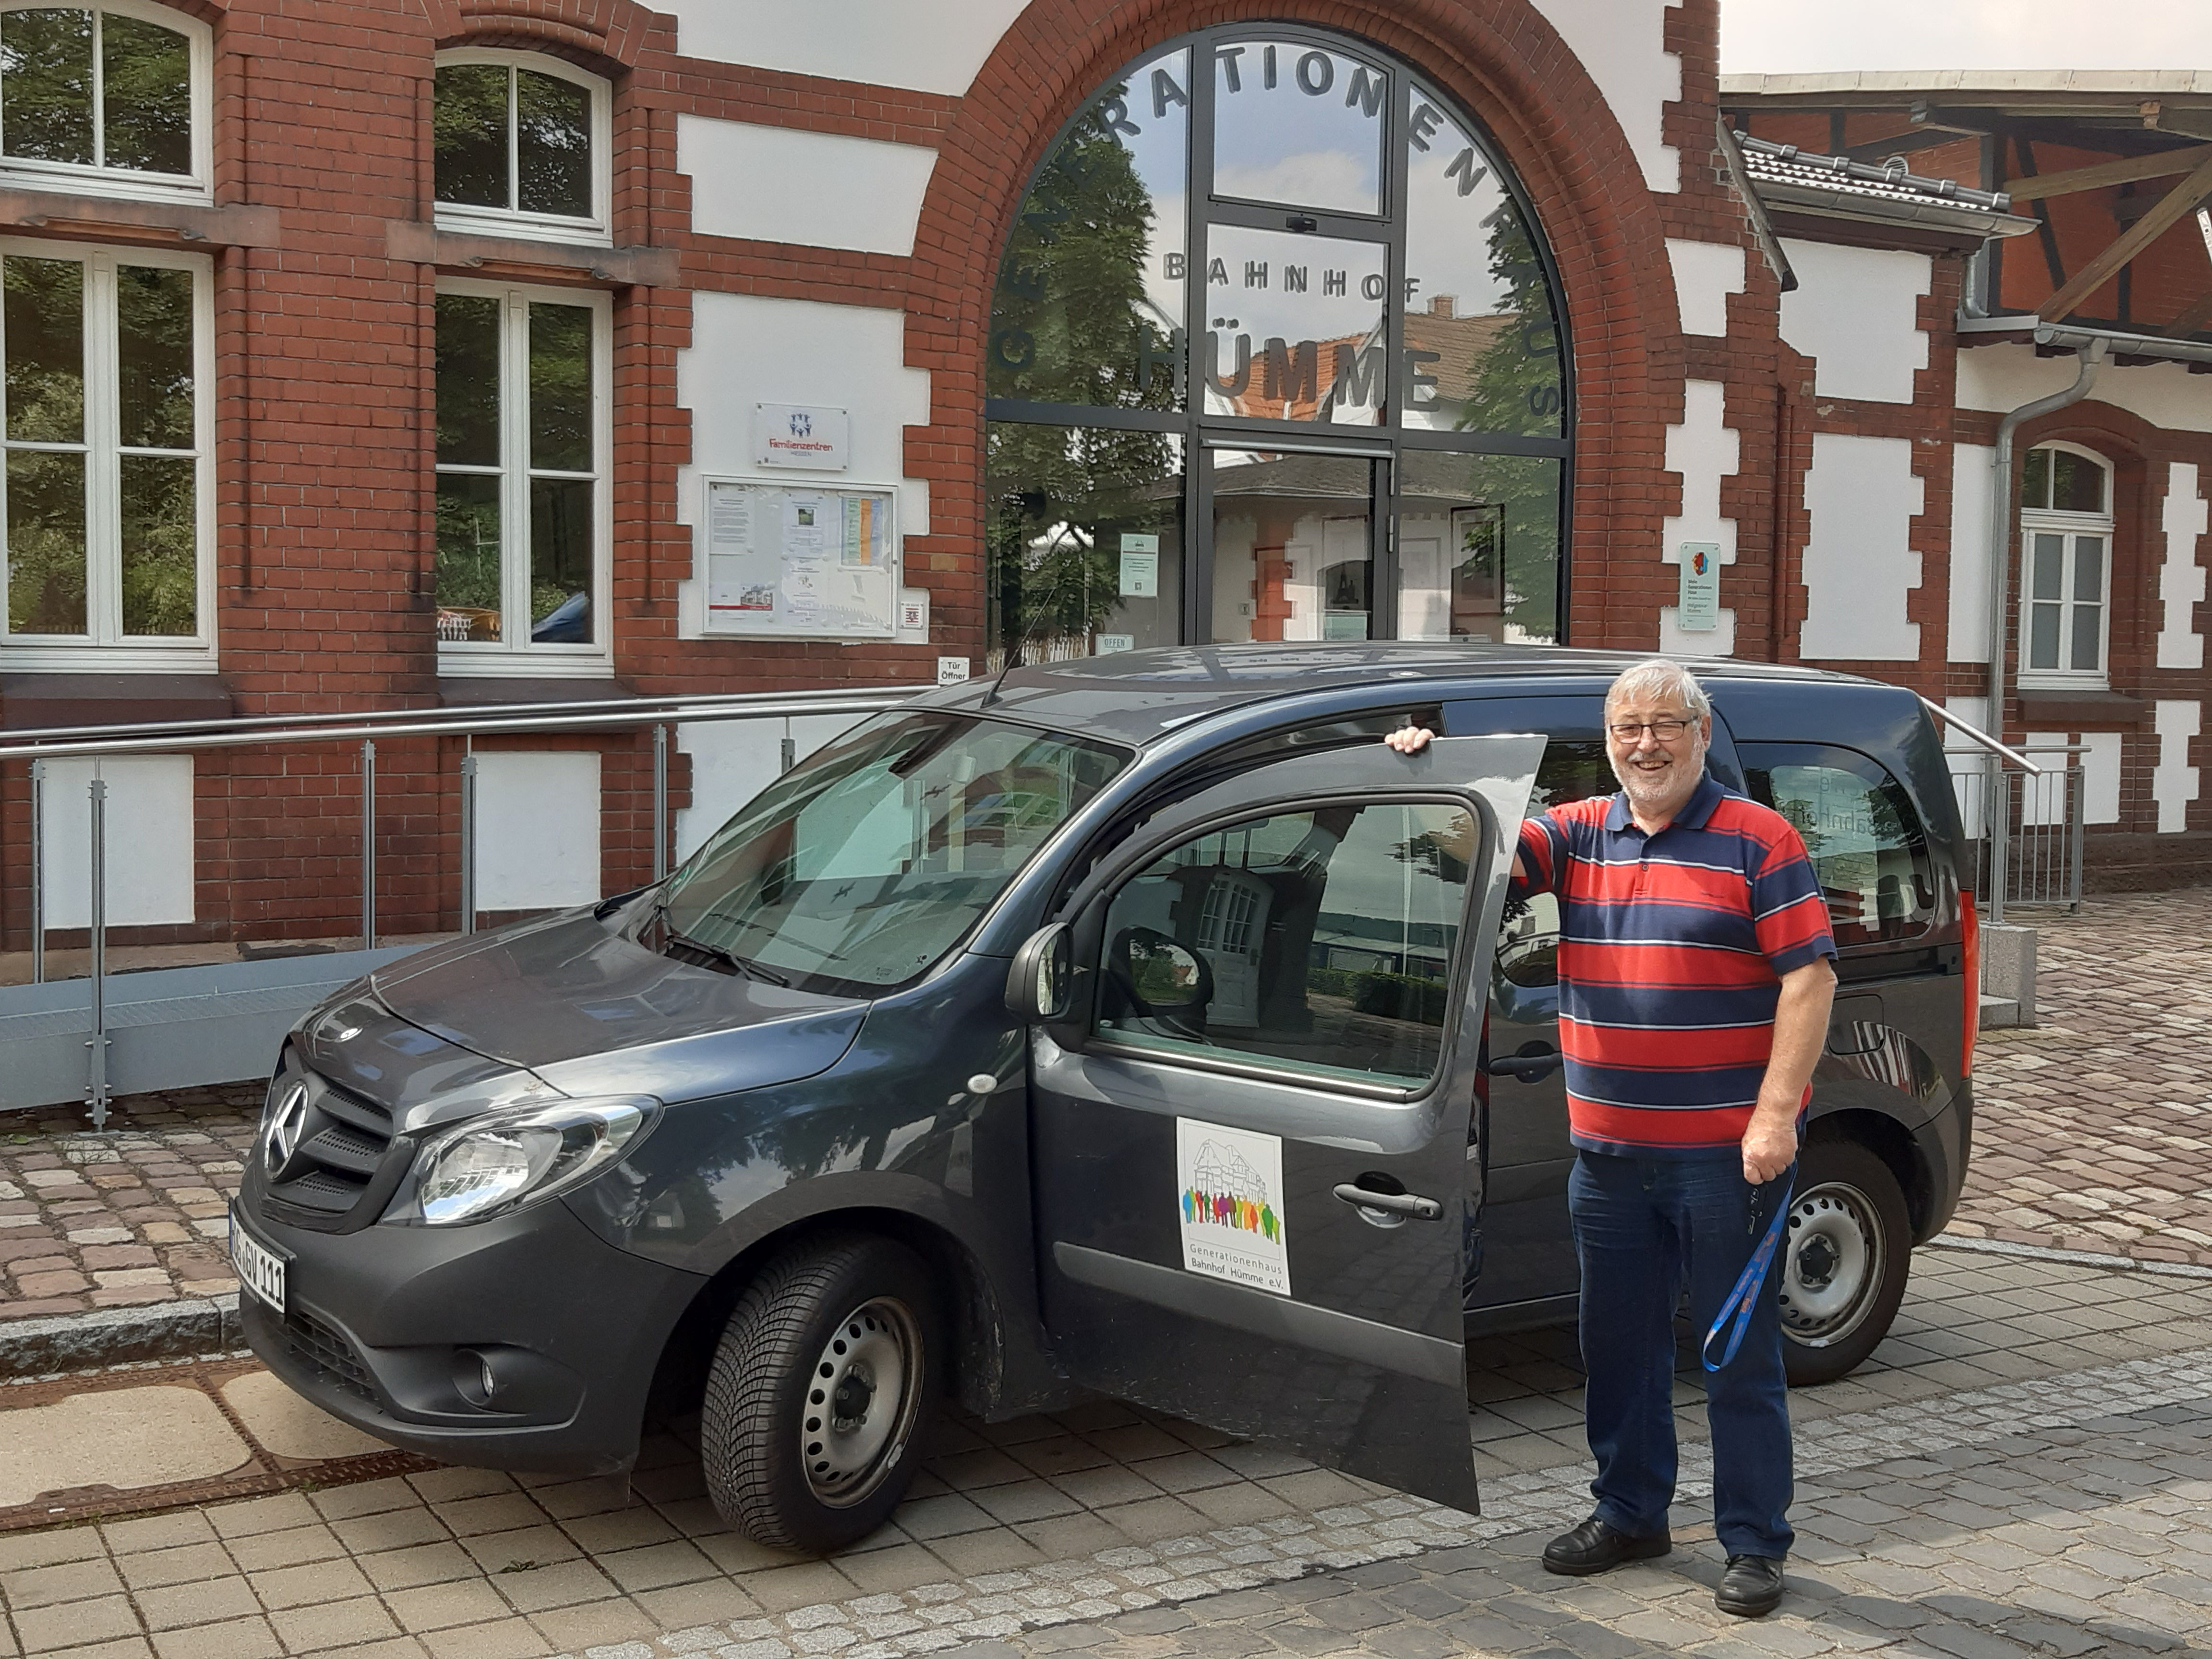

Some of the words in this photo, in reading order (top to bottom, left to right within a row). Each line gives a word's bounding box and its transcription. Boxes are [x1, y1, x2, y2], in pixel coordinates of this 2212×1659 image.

[1164, 252, 1420, 302] BAHNHOF
[1140, 317, 1440, 412] HÜMME
[769, 438, 833, 451] Familienzentren
[1104, 638, 1125, 647] OFFEN
[941, 671, 966, 680] Öffner
[245, 1240, 257, 1286] GV
[260, 1255, 283, 1306] 111
[1190, 1244, 1282, 1274] Generationenhaus
[1191, 1258, 1226, 1274] Bahnhof
[1231, 1266, 1263, 1284] Hümme
[1270, 1278, 1284, 1289] e.V.
